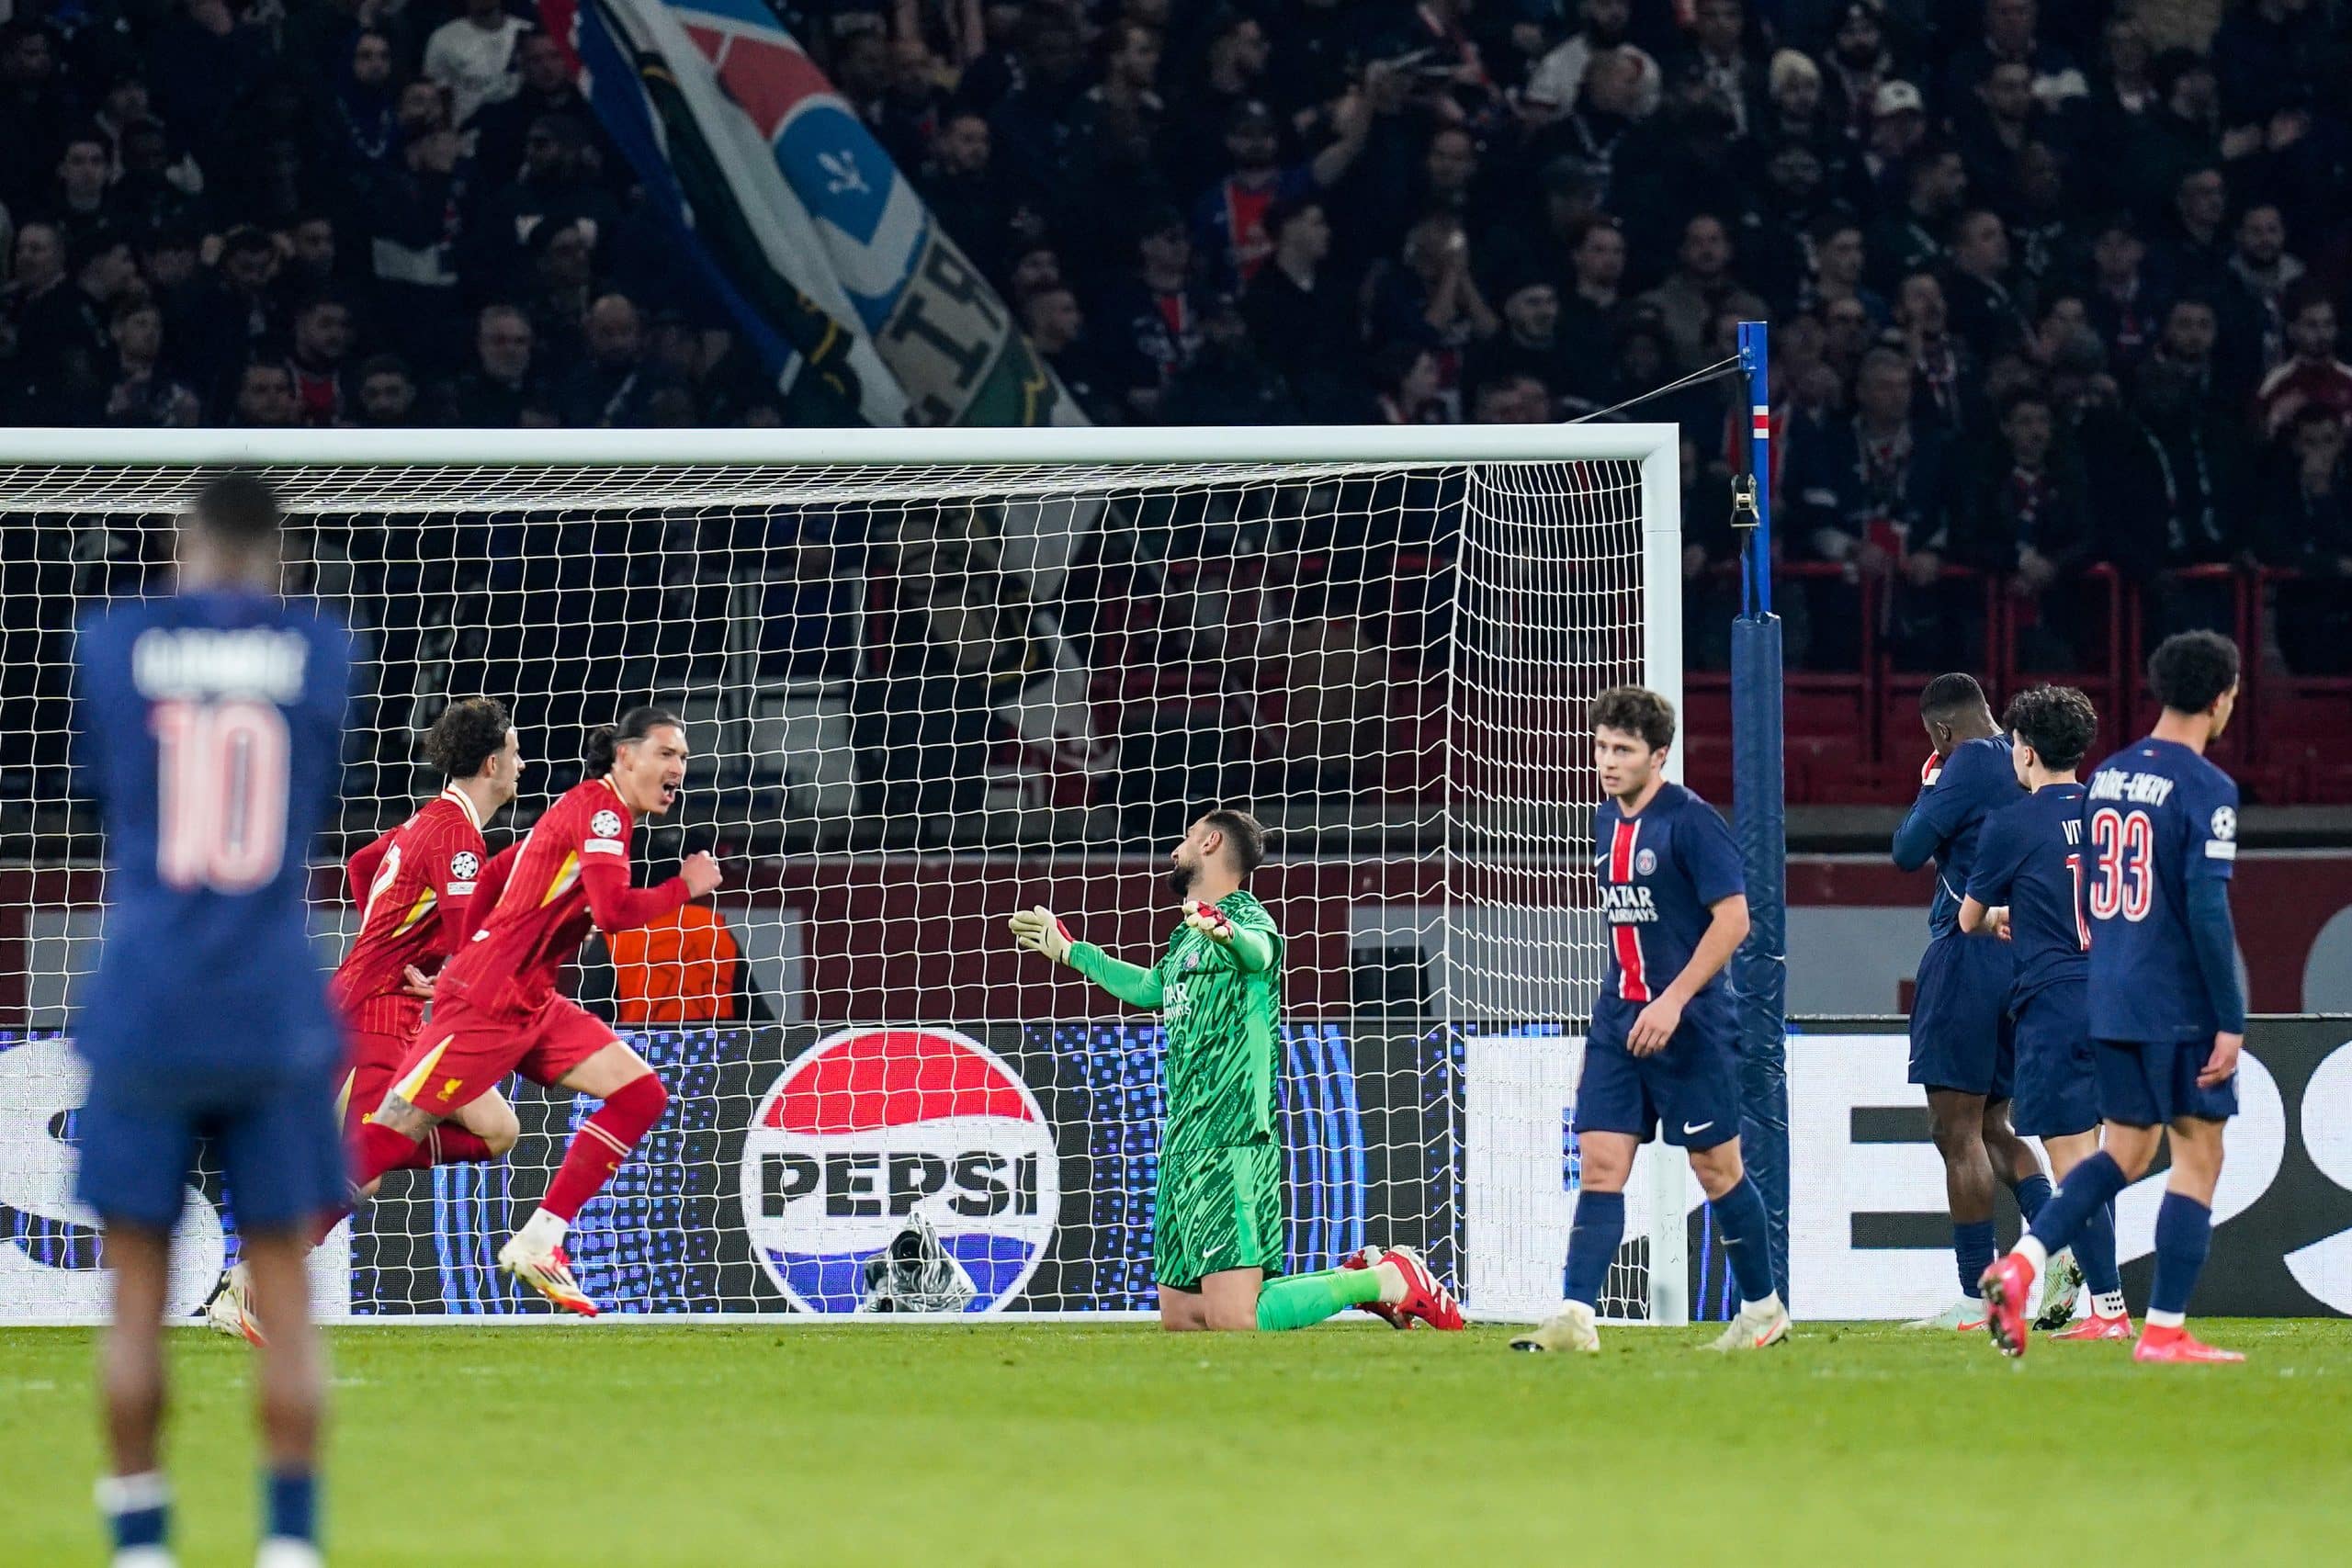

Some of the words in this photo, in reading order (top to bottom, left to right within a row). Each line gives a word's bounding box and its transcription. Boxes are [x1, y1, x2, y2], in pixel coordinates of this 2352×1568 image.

[144, 698, 291, 897] 10
[2065, 853, 2091, 951] 1
[2090, 807, 2154, 921] 33
[762, 1151, 1038, 1216] PEPSI
